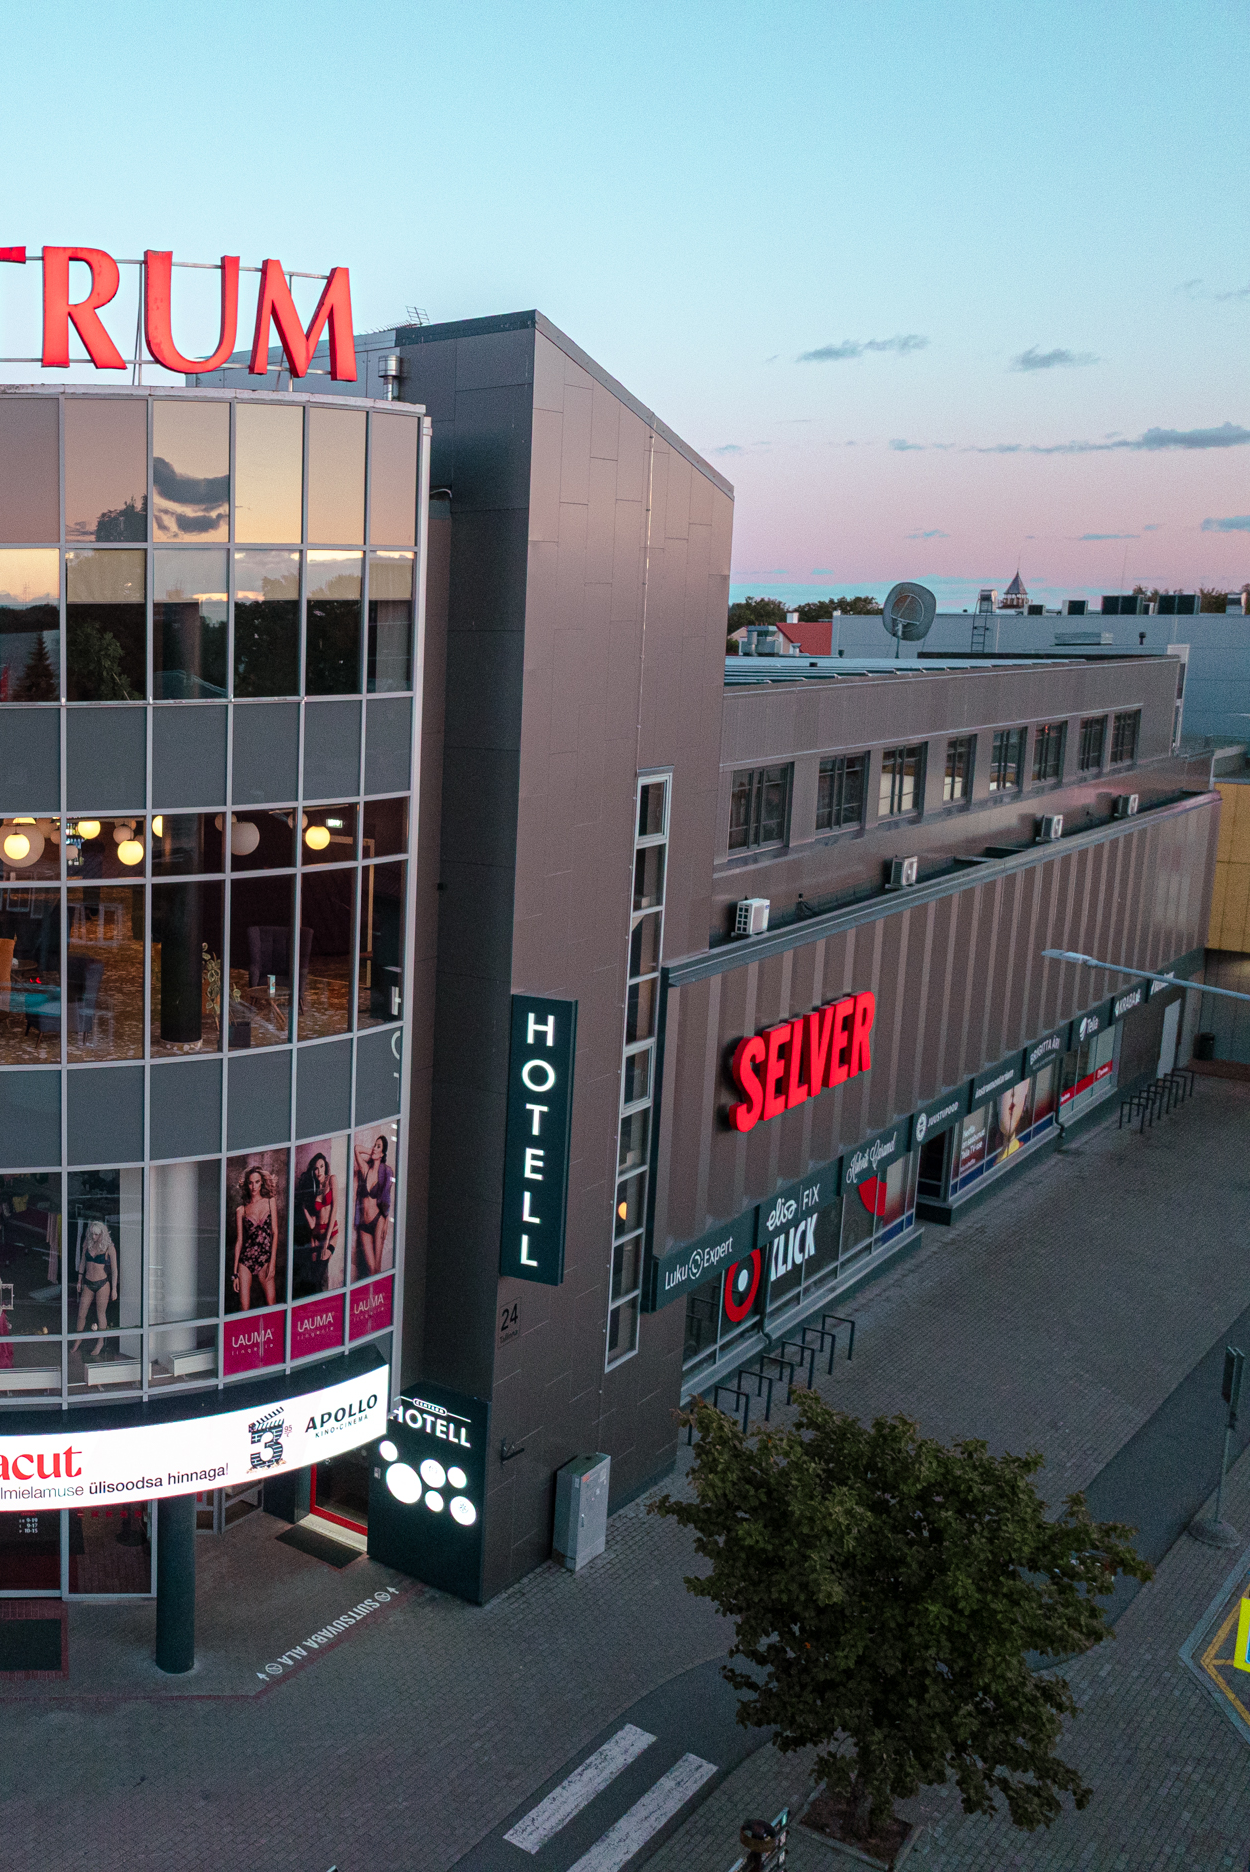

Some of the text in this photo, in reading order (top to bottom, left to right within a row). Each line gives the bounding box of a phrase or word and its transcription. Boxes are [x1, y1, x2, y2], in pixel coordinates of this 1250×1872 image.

[729, 990, 875, 1133] SELVER
[520, 1012, 556, 1267] HOTELL
[766, 1183, 820, 1231] elisa FIX
[665, 1236, 733, 1291] Luku Expert
[354, 1293, 384, 1314] LAUMA
[501, 1303, 518, 1331] 24
[232, 1329, 273, 1348] LAUMA
[297, 1312, 333, 1333] LAUMA
[305, 1394, 377, 1433] APOLLO
[89, 1476, 163, 1495] ülisoodsa
[168, 1463, 229, 1486] hinnaga!
[302, 1598, 381, 1649] SUITSUVABA
[277, 1645, 308, 1666] ALA
